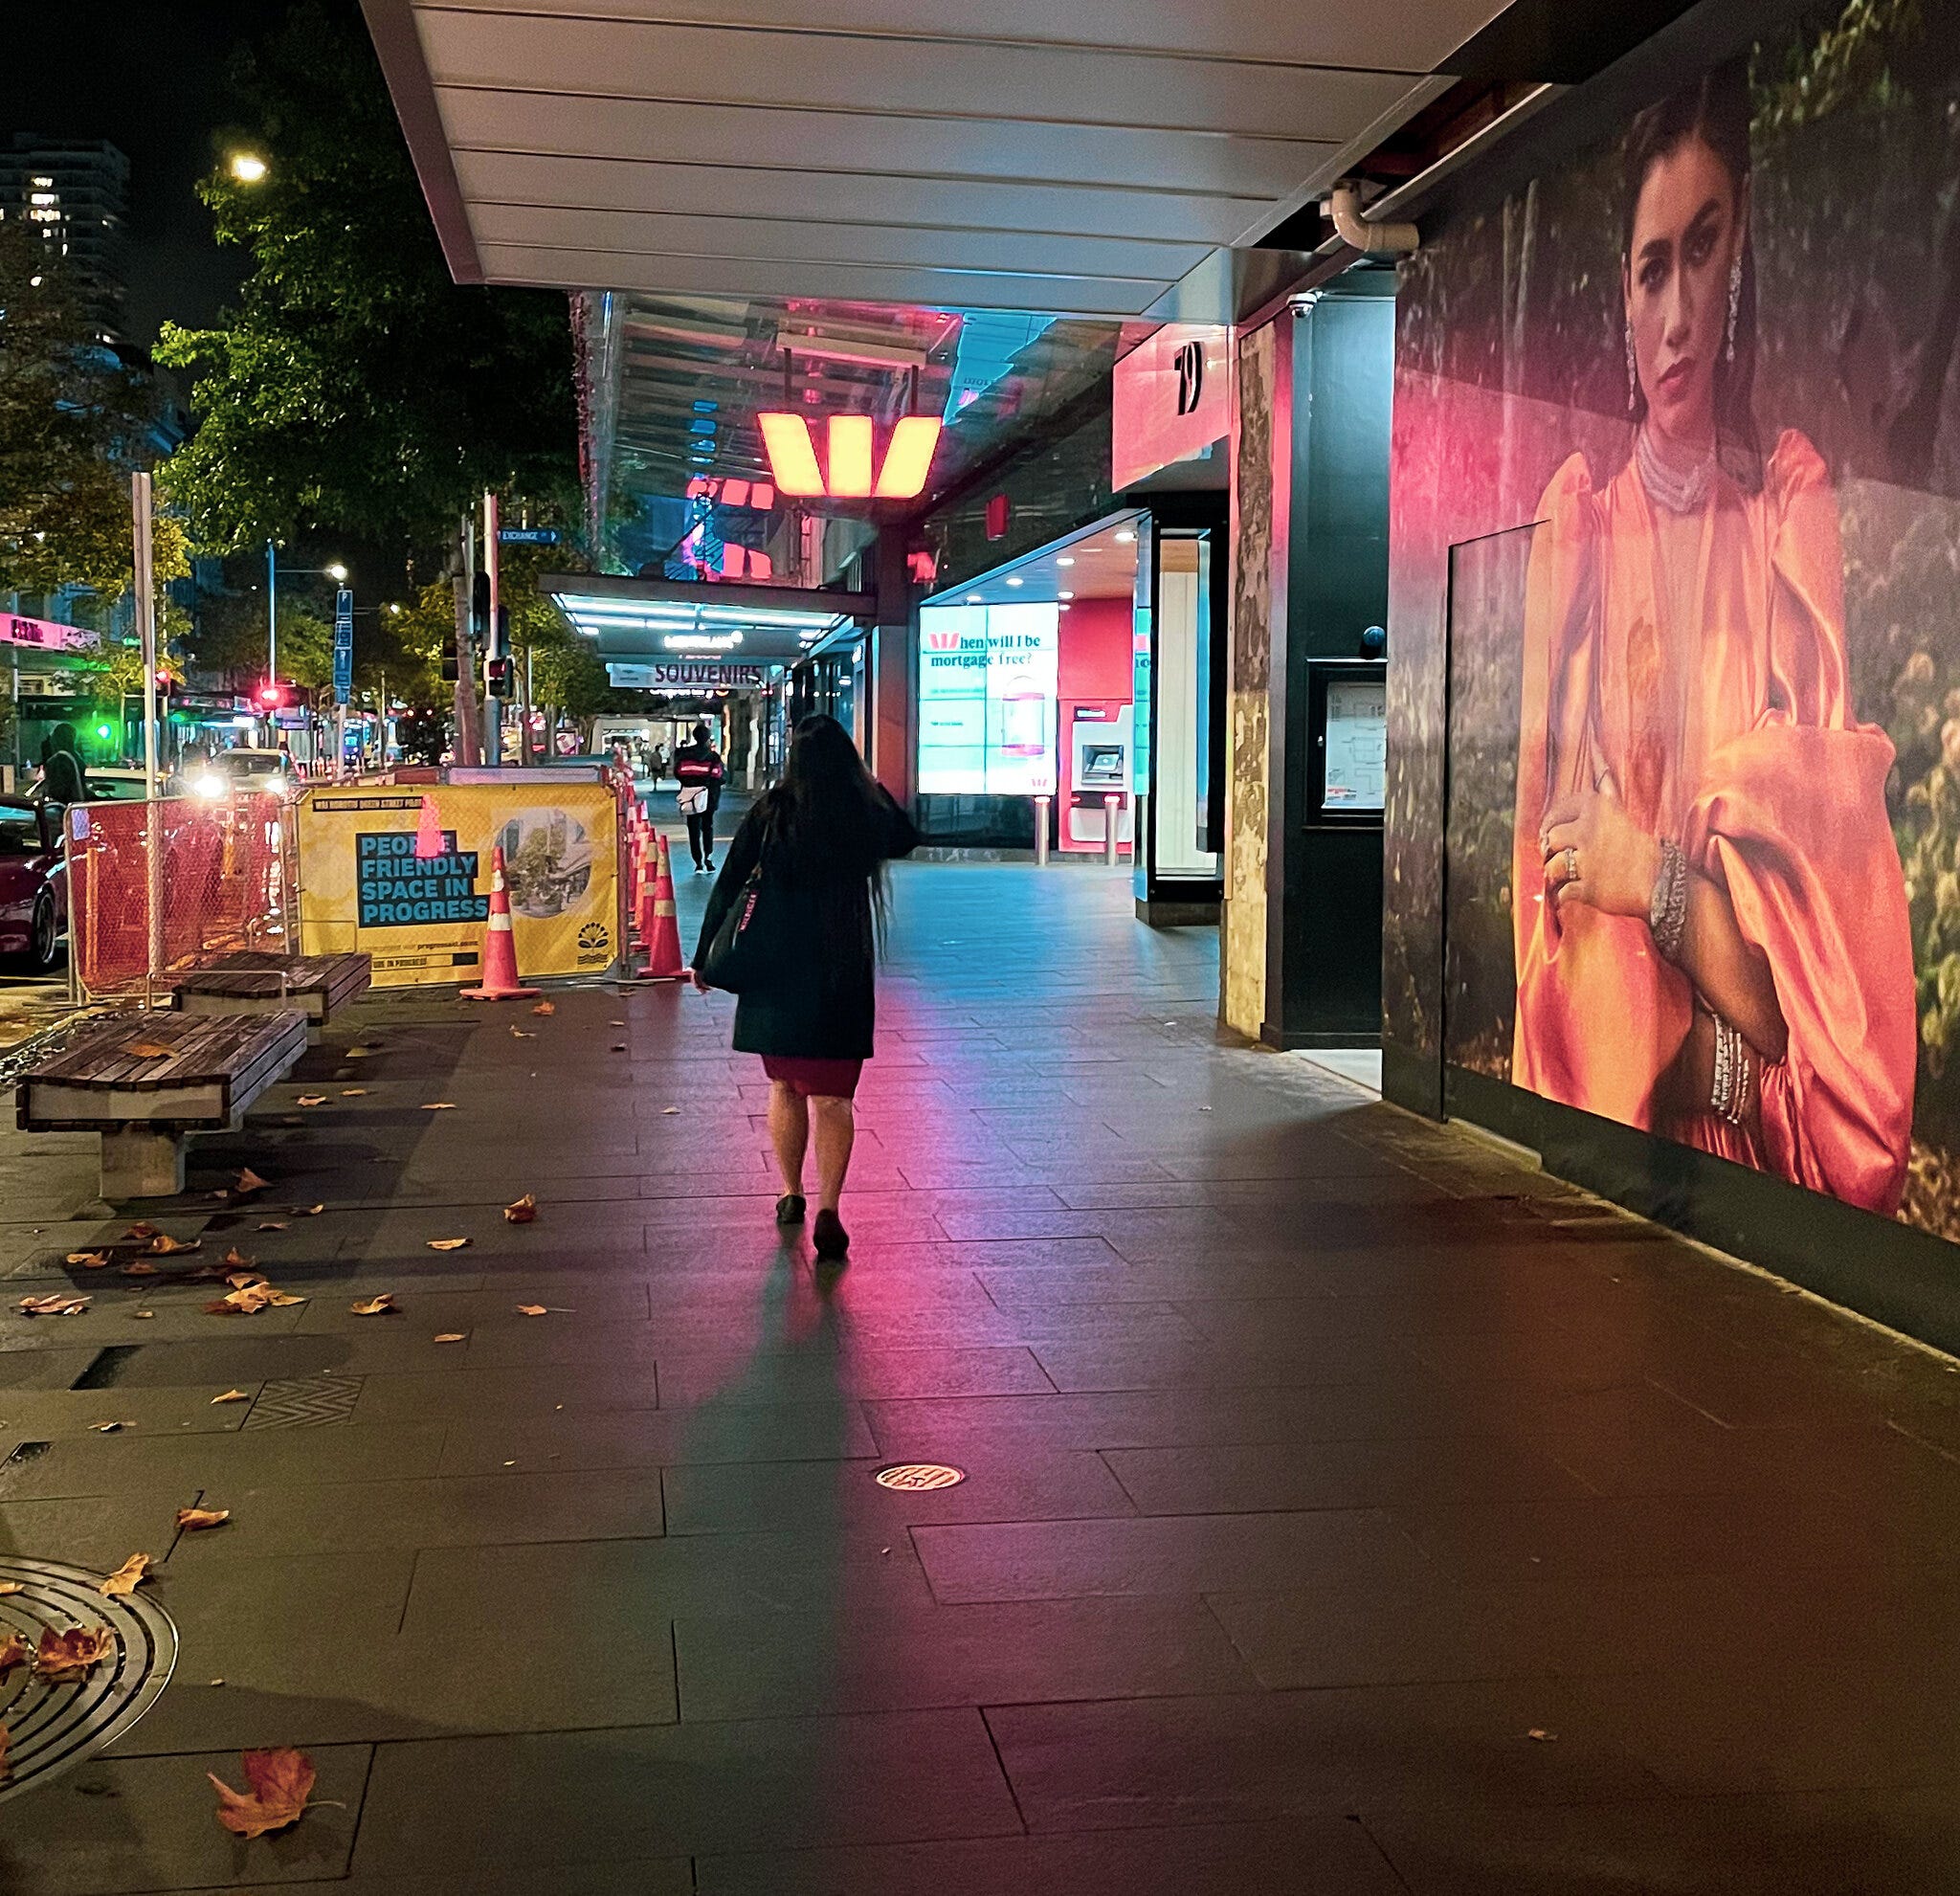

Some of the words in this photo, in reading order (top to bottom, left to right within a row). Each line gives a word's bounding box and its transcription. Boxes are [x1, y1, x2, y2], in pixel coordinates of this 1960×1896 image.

[988, 636, 1013, 648] will
[1025, 636, 1040, 647] be
[931, 655, 993, 669] mortgage
[999, 652, 1033, 665] free?
[655, 663, 763, 685] SOUVENIRS
[361, 835, 452, 856] PEOE
[362, 856, 477, 878] FRIENDLY
[362, 879, 438, 901] SPACE
[444, 878, 469, 897] IN
[364, 898, 488, 924] PROGRESS
